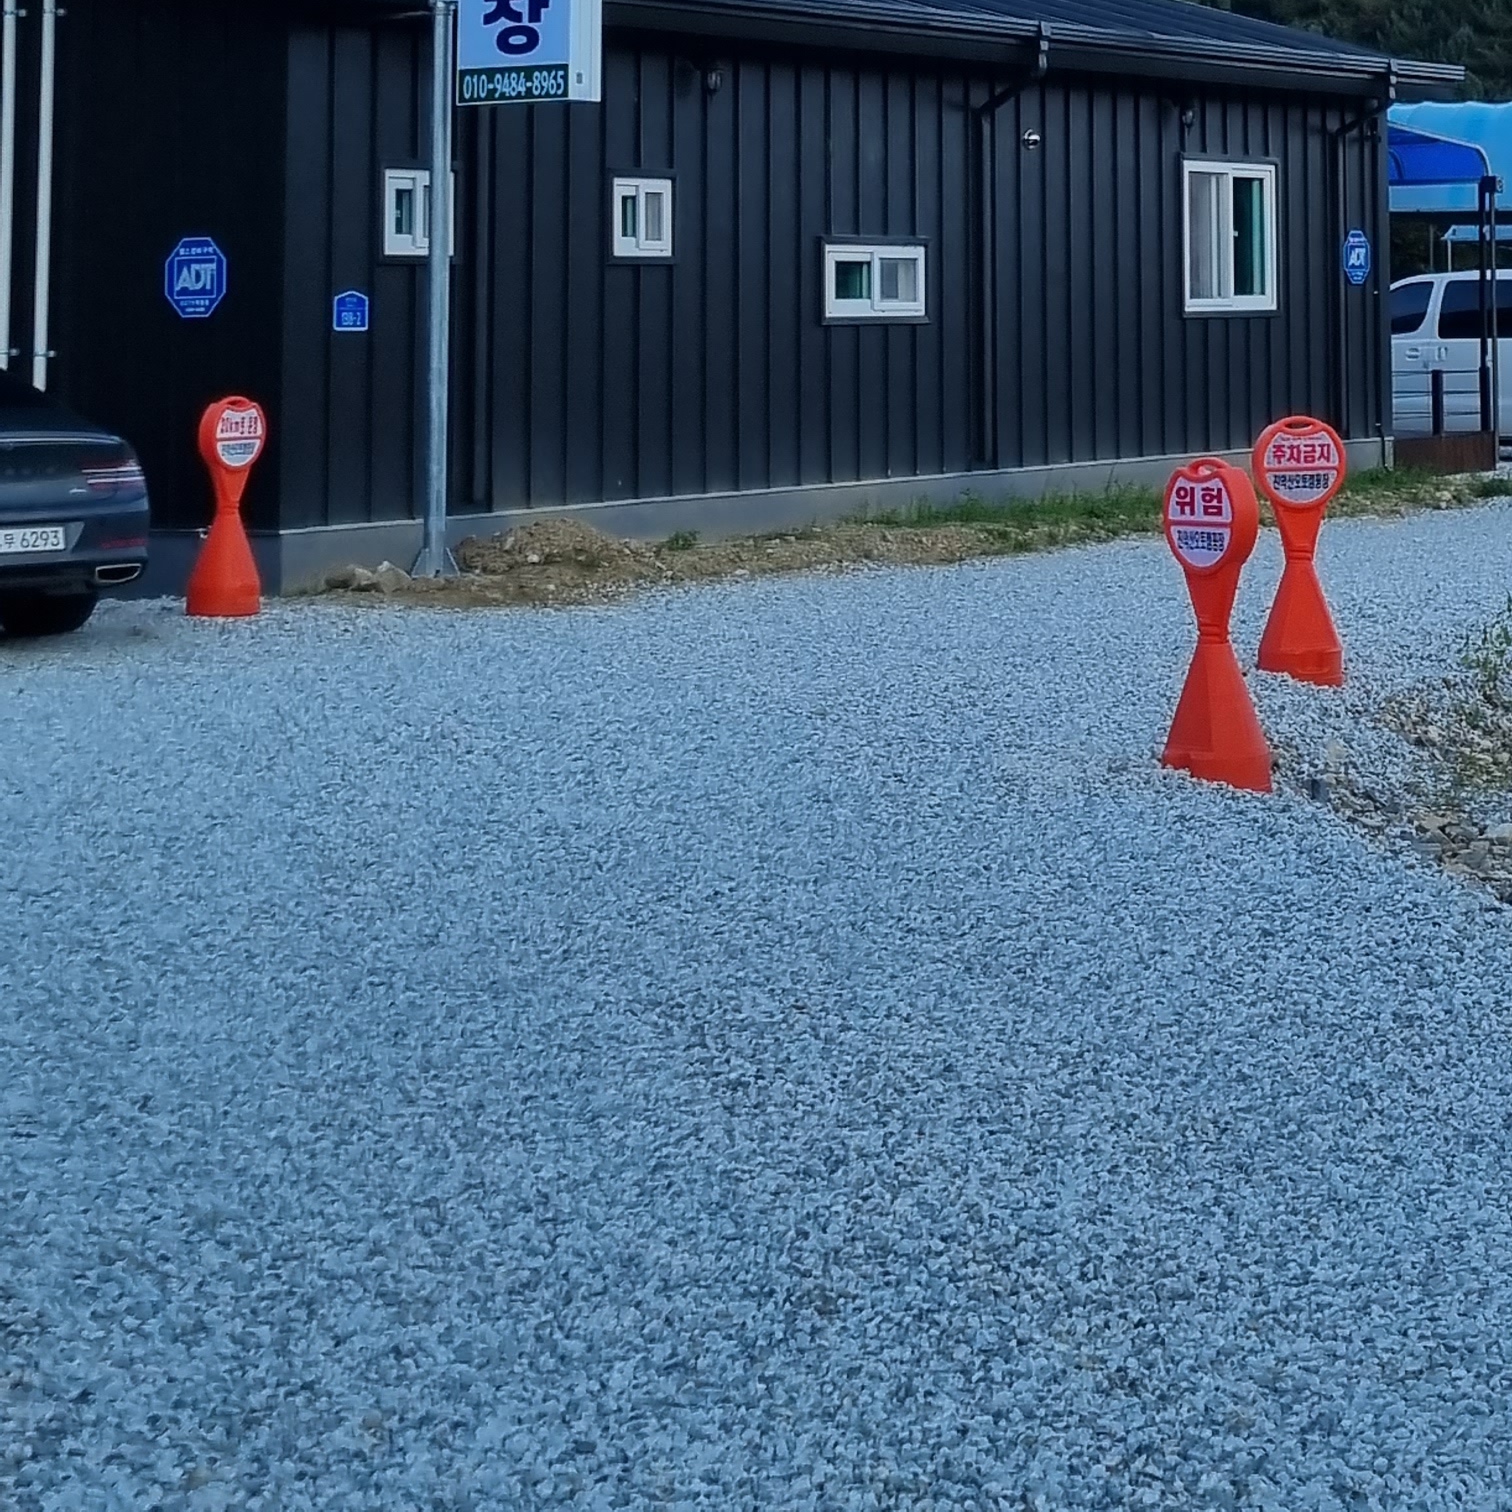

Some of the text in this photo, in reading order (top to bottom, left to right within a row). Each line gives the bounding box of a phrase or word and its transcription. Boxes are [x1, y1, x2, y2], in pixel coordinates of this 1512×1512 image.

[463, 70, 565, 99] 010-9484-8965
[175, 263, 217, 291] ADT
[1272, 443, 1331, 465] 주차금지
[1175, 485, 1223, 517] 위험
[20, 530, 60, 549] 6293
